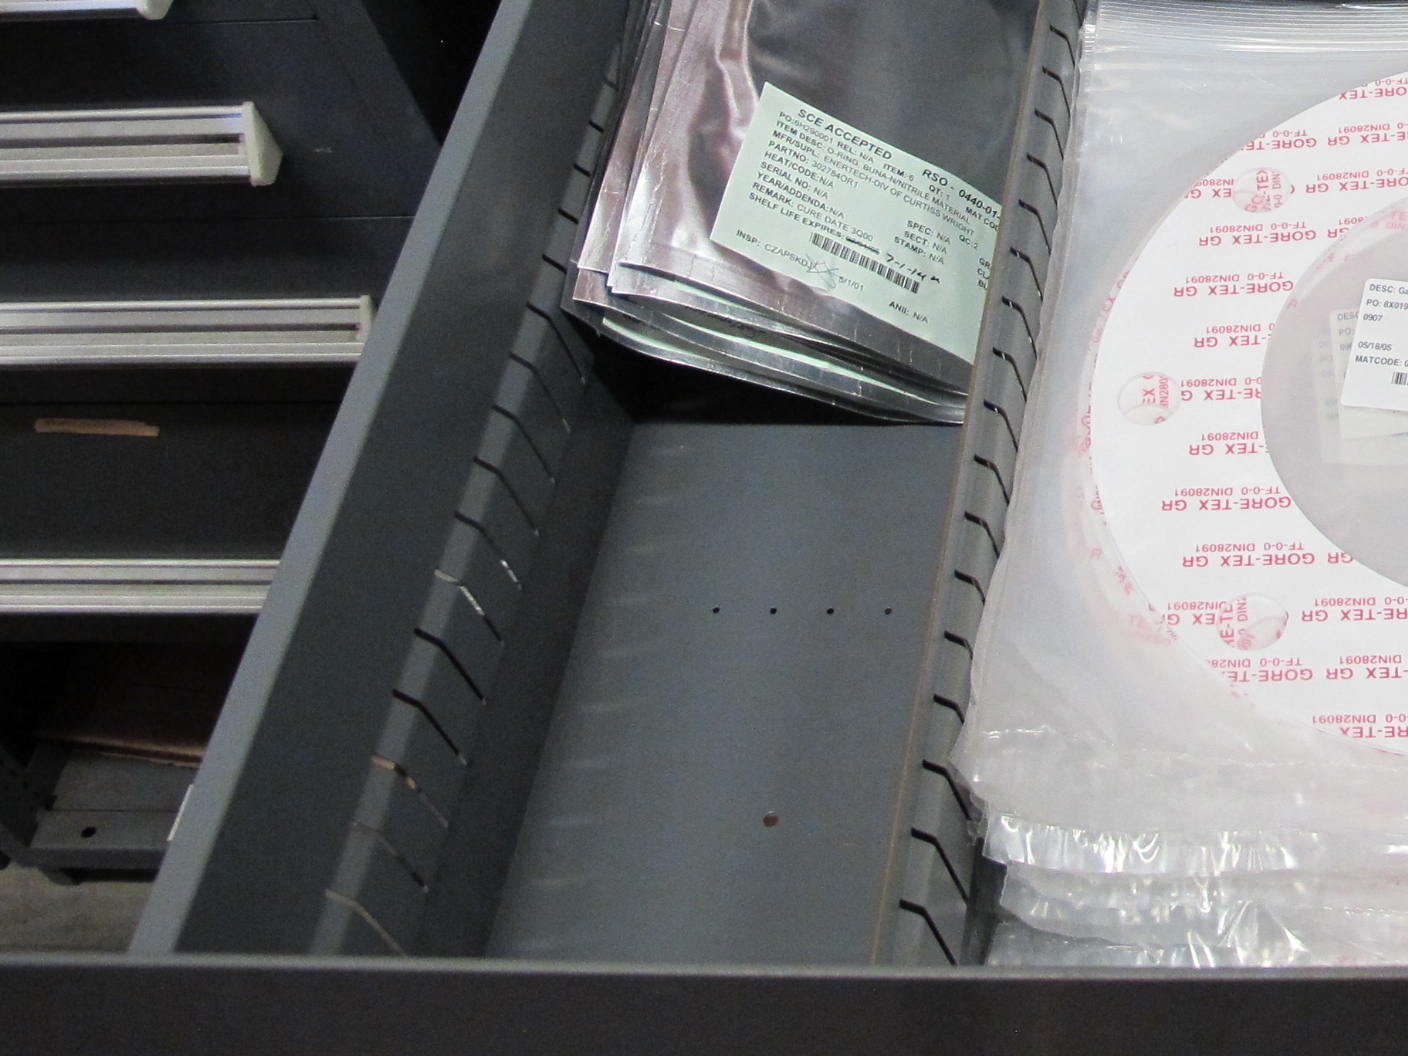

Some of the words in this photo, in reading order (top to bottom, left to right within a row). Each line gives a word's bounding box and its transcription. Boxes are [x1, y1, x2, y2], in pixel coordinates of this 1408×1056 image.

[767, 139, 811, 166] PARTNO:
[796, 108, 825, 128] SCE
[824, 122, 894, 161] ACCEPTED
[921, 168, 950, 188] RSO
[774, 120, 798, 137] ITEM
[929, 196, 974, 225] MATERIAL
[751, 181, 796, 207] REMARK:
[795, 203, 823, 221] CURE
[823, 215, 852, 234] DATE
[759, 161, 794, 182] SERIAL
[793, 177, 812, 192] NO:
[812, 187, 830, 200] N/A
[931, 243, 949, 256] N/A
[748, 192, 780, 212] SHELF
[779, 207, 801, 222] LIFE
[801, 215, 844, 241] EXPIRES:
[901, 194, 942, 219] CURTISS
[940, 213, 977, 237] WRIGHT
[1271, 221, 1307, 230] TF-0-0
[906, 219, 935, 237] SPEC:
[934, 232, 953, 246] N/A
[1232, 230, 1316, 245] GORE-TEX
[892, 236, 928, 257] STAMP:
[927, 252, 946, 266] N/A
[1174, 286, 1197, 297] GR
[1208, 280, 1293, 295] GORE-TEX
[1369, 284, 1396, 294] DESC:
[1366, 299, 1382, 308] PO:
[913, 312, 929, 324] N/A
[1363, 314, 1383, 322] 0907
[1355, 355, 1403, 367] MATCODE:
[1201, 431, 1259, 441] DIN28091
[1162, 500, 1187, 511] GR
[1314, 598, 1376, 606] DIN28091
[1302, 610, 1328, 622] GR
[1312, 714, 1376, 724] DIN28091
